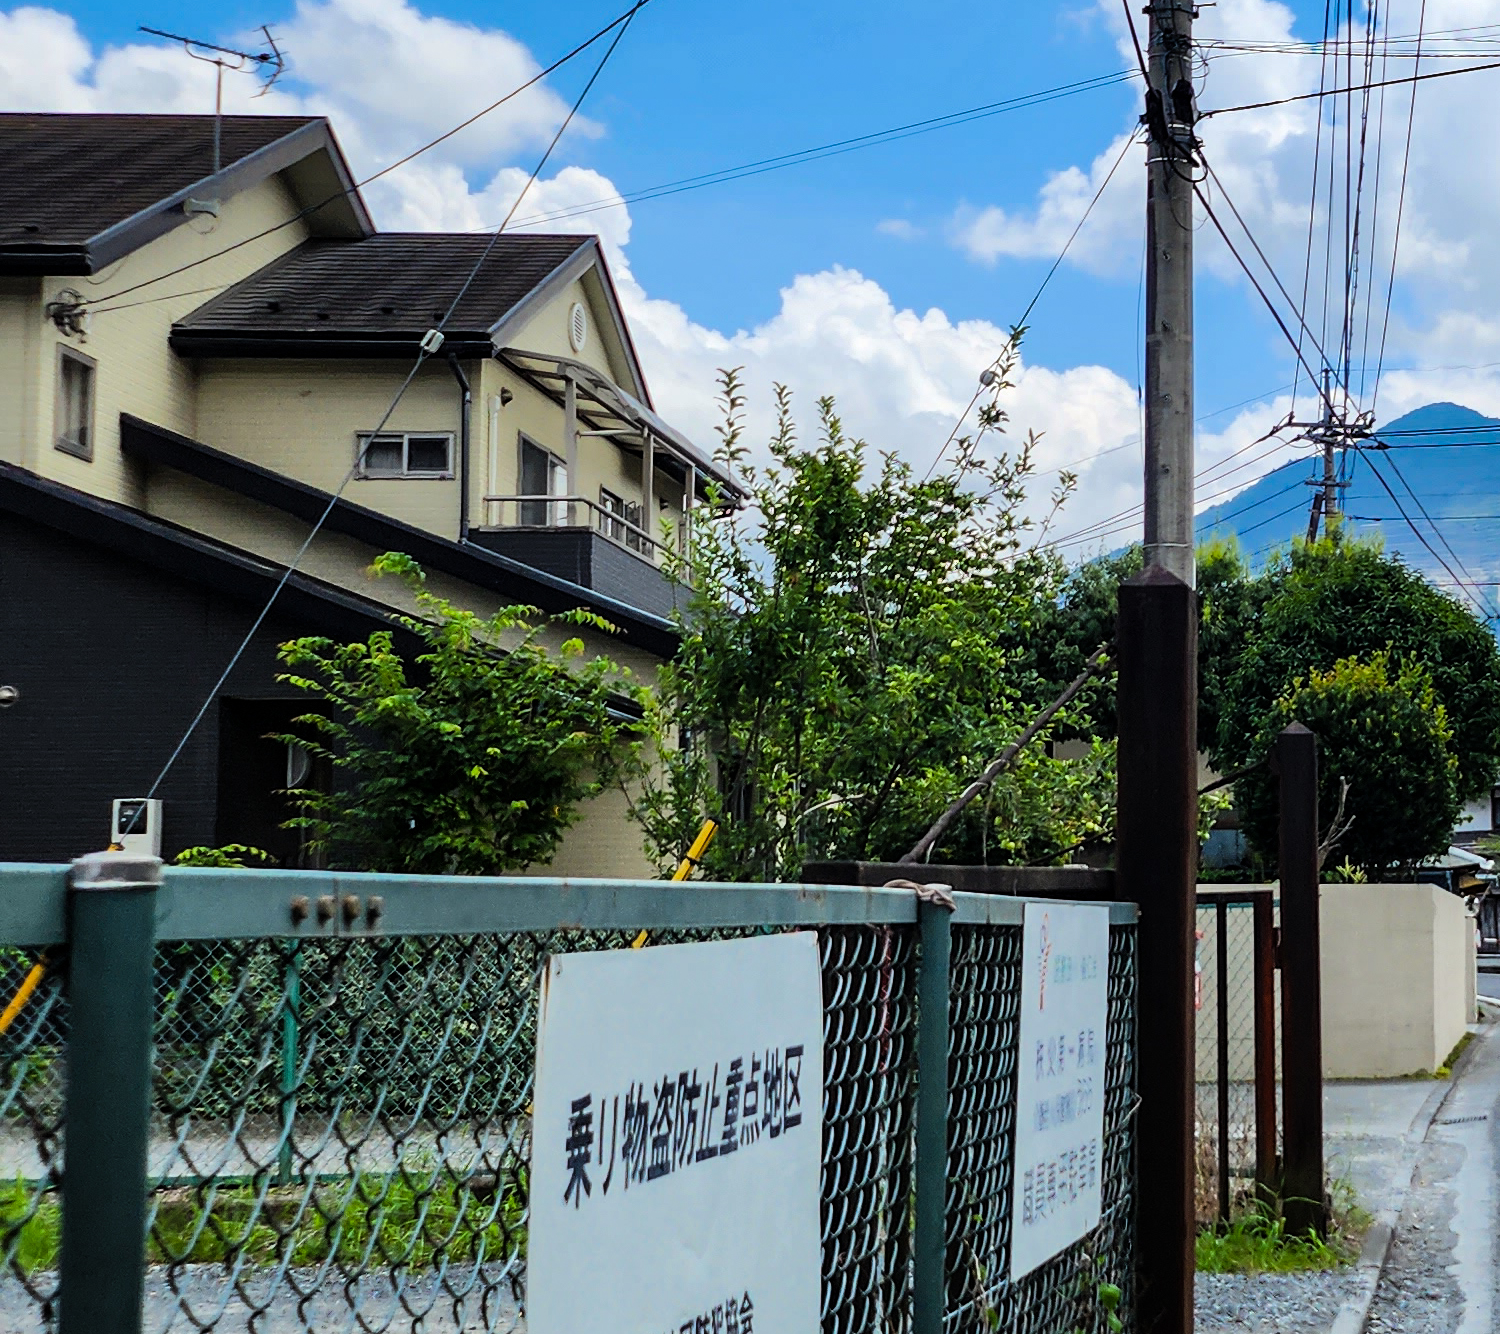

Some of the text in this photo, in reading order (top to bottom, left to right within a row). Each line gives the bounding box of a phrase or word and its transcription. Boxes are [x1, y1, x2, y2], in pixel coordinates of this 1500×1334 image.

[563, 1043, 804, 1210] 乗り物盗防止重点地区
